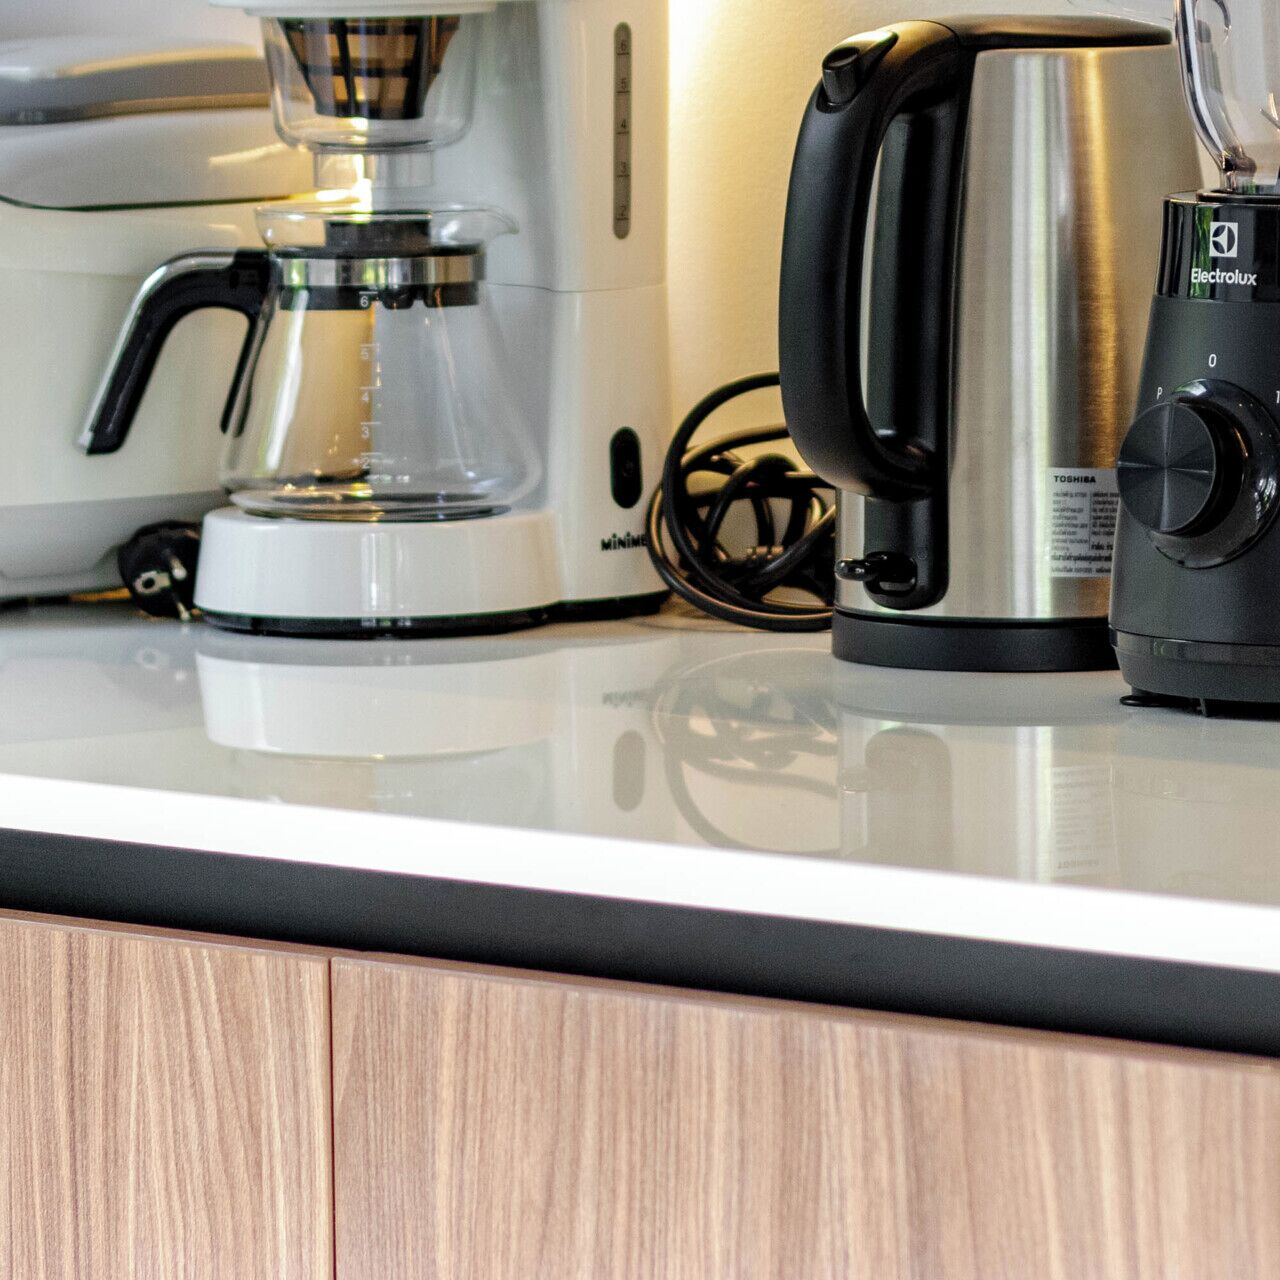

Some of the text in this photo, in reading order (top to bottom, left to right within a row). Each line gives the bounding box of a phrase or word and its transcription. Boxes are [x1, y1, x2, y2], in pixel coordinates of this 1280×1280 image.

[1191, 268, 1257, 286] Electrolux
[360, 295, 369, 308] 6
[1208, 354, 1217, 367] 0
[361, 391, 370, 403] 4
[1156, 386, 1163, 400] P
[1275, 391, 1280, 404] 1
[361, 426, 370, 438] 3
[1054, 475, 1096, 483] TOSHIBA
